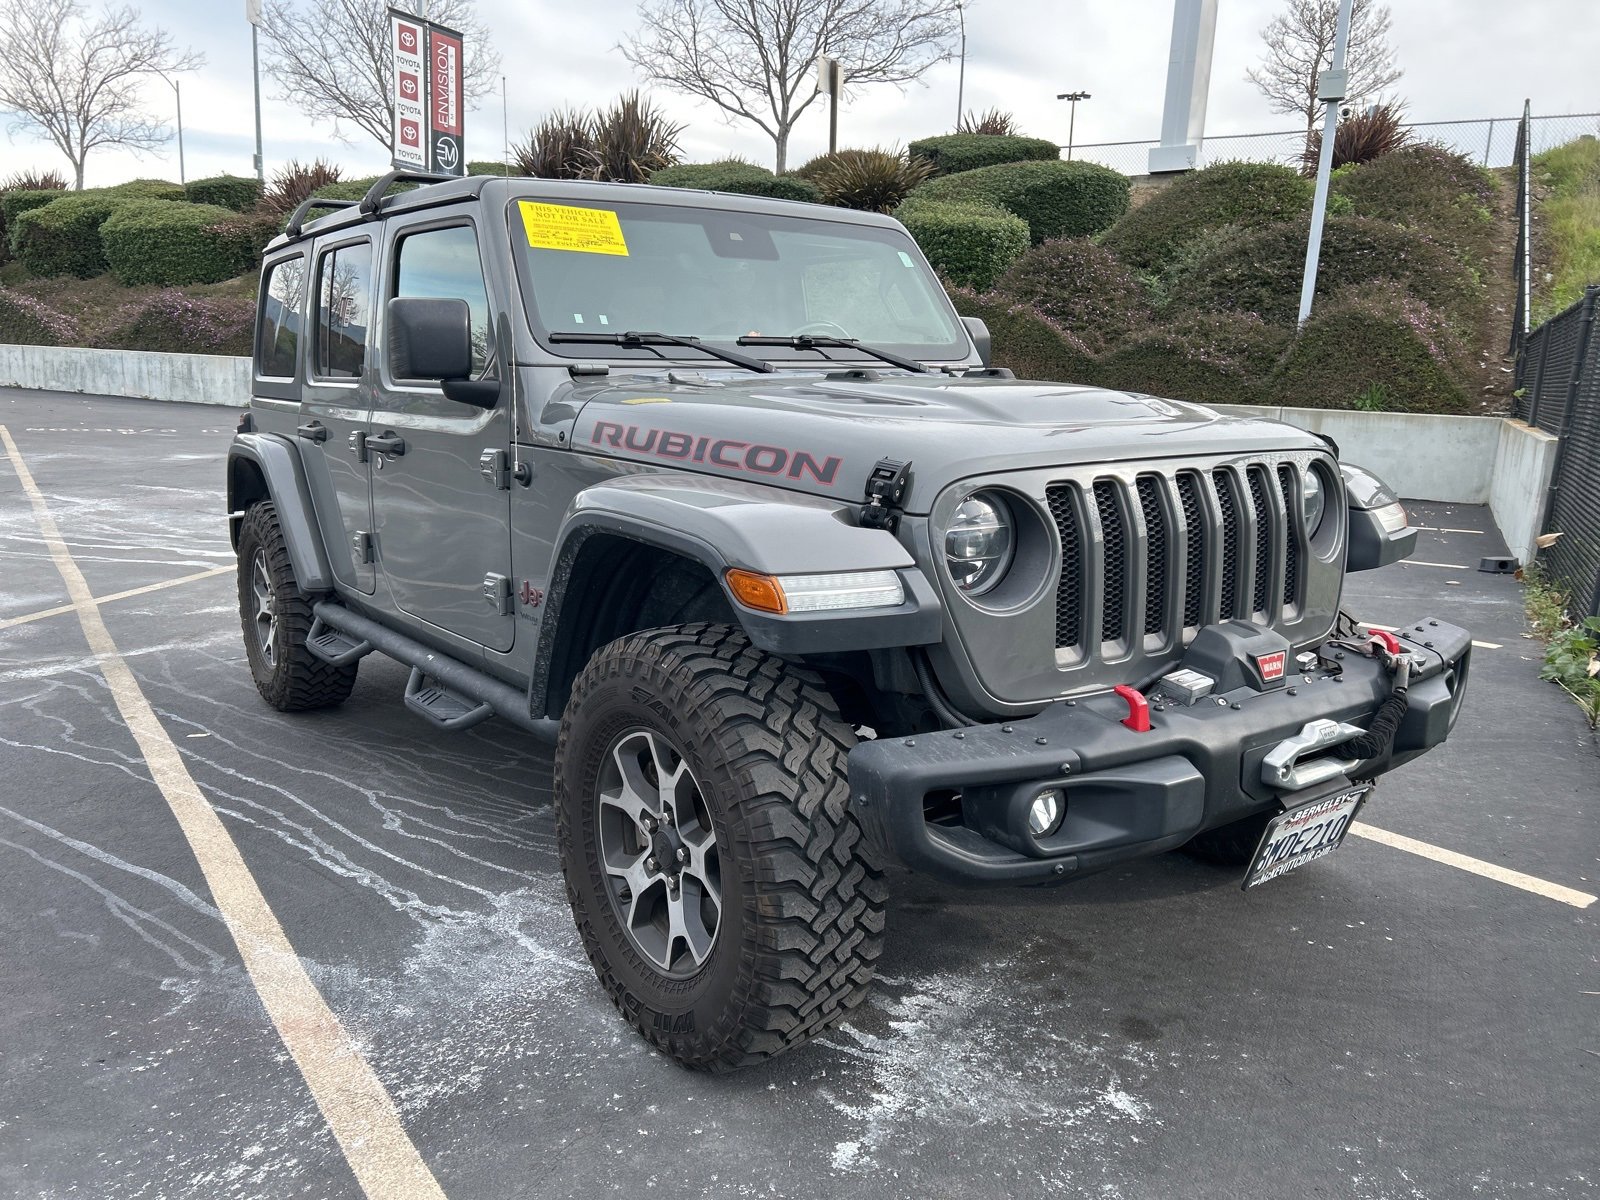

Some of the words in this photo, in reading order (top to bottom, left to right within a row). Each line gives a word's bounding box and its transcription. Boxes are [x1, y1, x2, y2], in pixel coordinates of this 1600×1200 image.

[396, 55, 421, 70] TOYOTA
[437, 42, 448, 128] ENVISION
[397, 103, 422, 116] TOYOTA
[398, 149, 423, 161] TOYOTA
[536, 211, 556, 219] NOT
[559, 214, 579, 222] FOR
[581, 216, 605, 225] SALE
[554, 207, 596, 218] VEHICLE
[591, 421, 843, 487] RUBICON
[1263, 660, 1282, 672] WARN
[1294, 794, 1349, 820] BERKELEY
